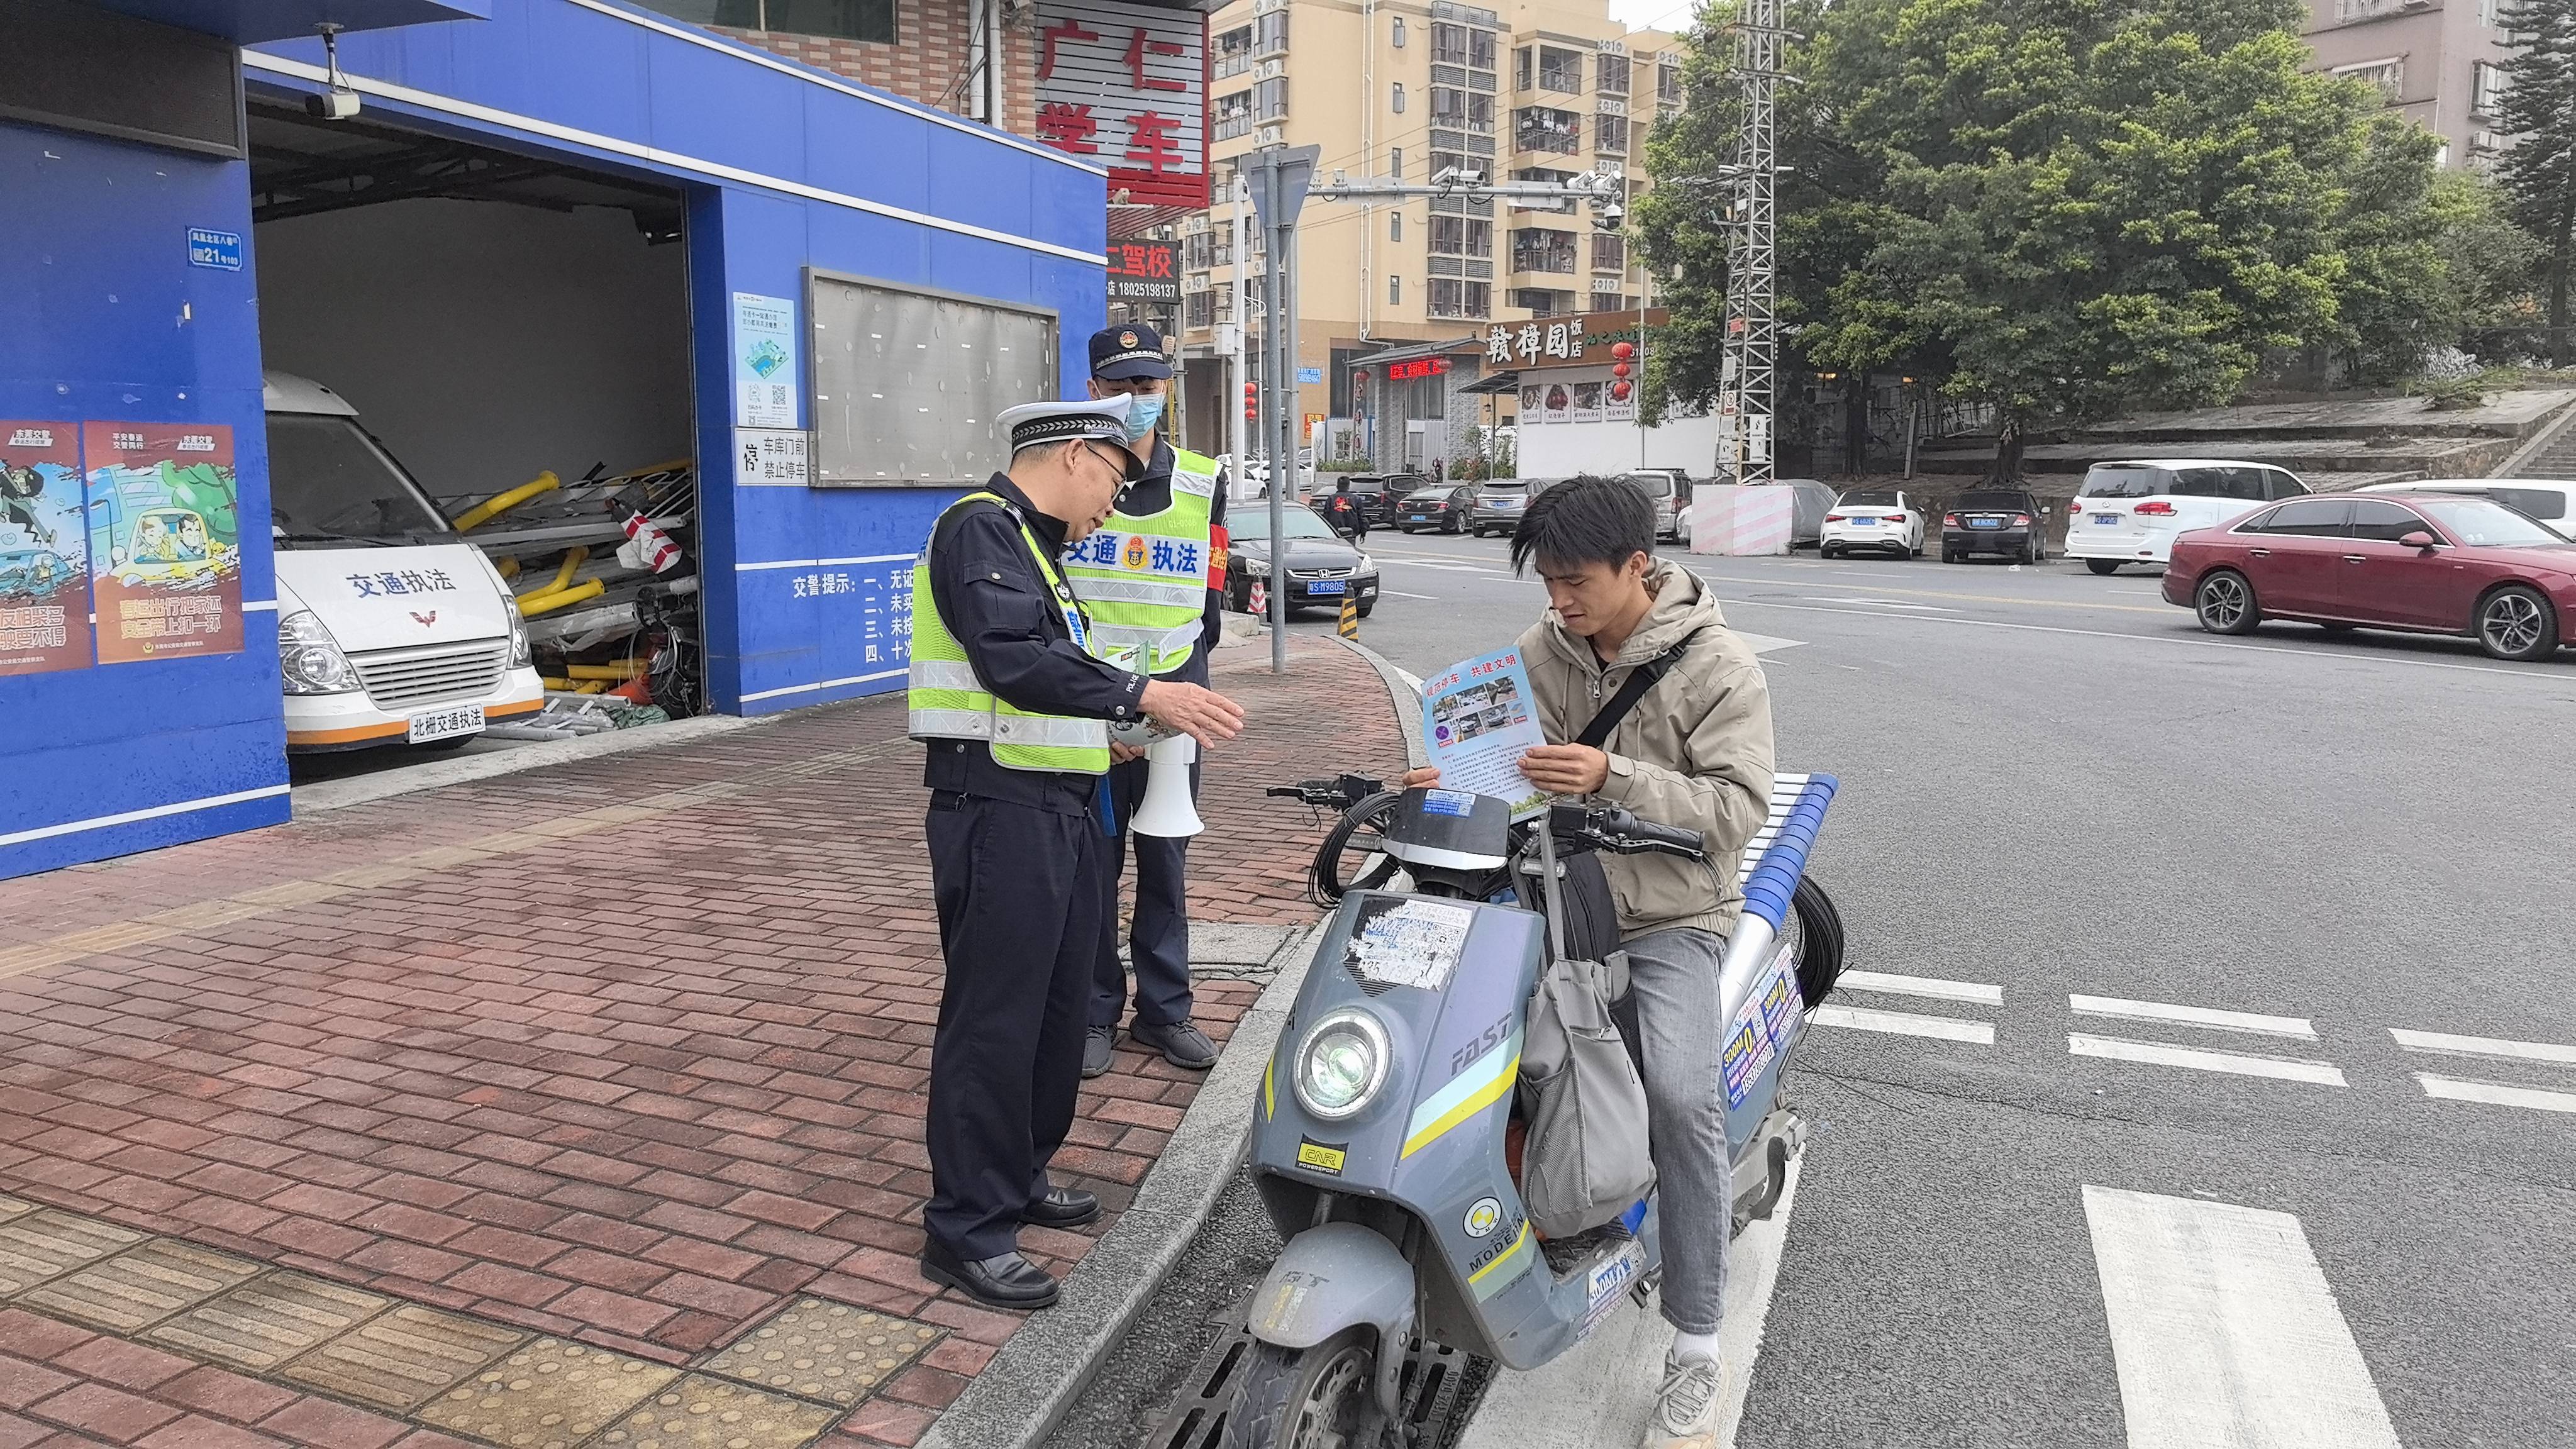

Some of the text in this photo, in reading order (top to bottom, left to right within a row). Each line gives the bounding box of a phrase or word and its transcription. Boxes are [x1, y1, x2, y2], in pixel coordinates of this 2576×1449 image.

[1119, 282, 1175, 298] 18025198137
[1486, 318, 1583, 366] 赣樟园 饭店
[763, 436, 804, 456] 车库门前
[764, 460, 805, 480] 禁止停车
[1067, 535, 1117, 565] 交通
[1152, 540, 1197, 574] 执法
[346, 569, 457, 598] 交通执法
[120, 596, 222, 619] 春运出行把家还
[121, 614, 221, 639] 安全带上扣一环
[1470, 654, 1516, 678] 共建文明
[1126, 673, 1140, 693] POLICE
[414, 708, 482, 738] 北栅交通执法
[1451, 1011, 1513, 1076] FAST
[1723, 1033, 1744, 1068] 300M
[1298, 1162, 1339, 1175] POWERSPORT
